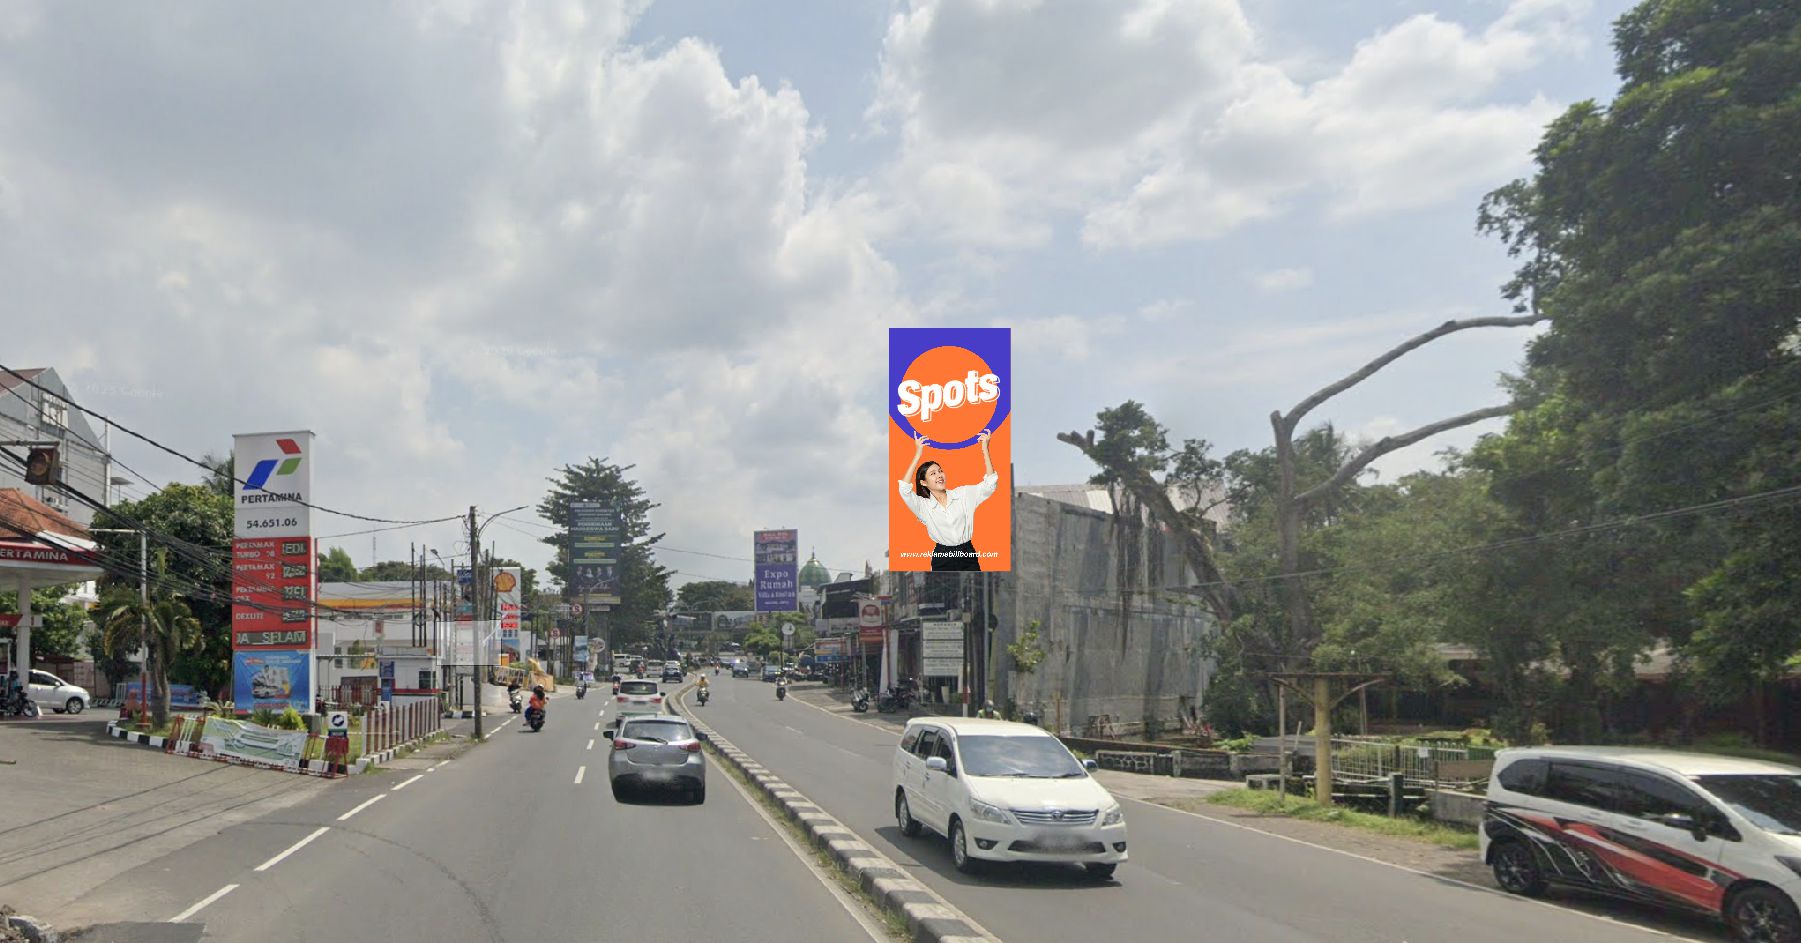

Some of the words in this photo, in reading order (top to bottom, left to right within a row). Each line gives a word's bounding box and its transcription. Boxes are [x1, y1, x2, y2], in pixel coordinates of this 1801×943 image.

[896, 370, 1001, 422] Spots
[241, 492, 303, 504] PERTAMINA
[246, 518, 298, 529] 54.651.06
[0, 548, 69, 561] ERTAMINA
[764, 570, 789, 580] Expo
[760, 581, 793, 590] Rumah
